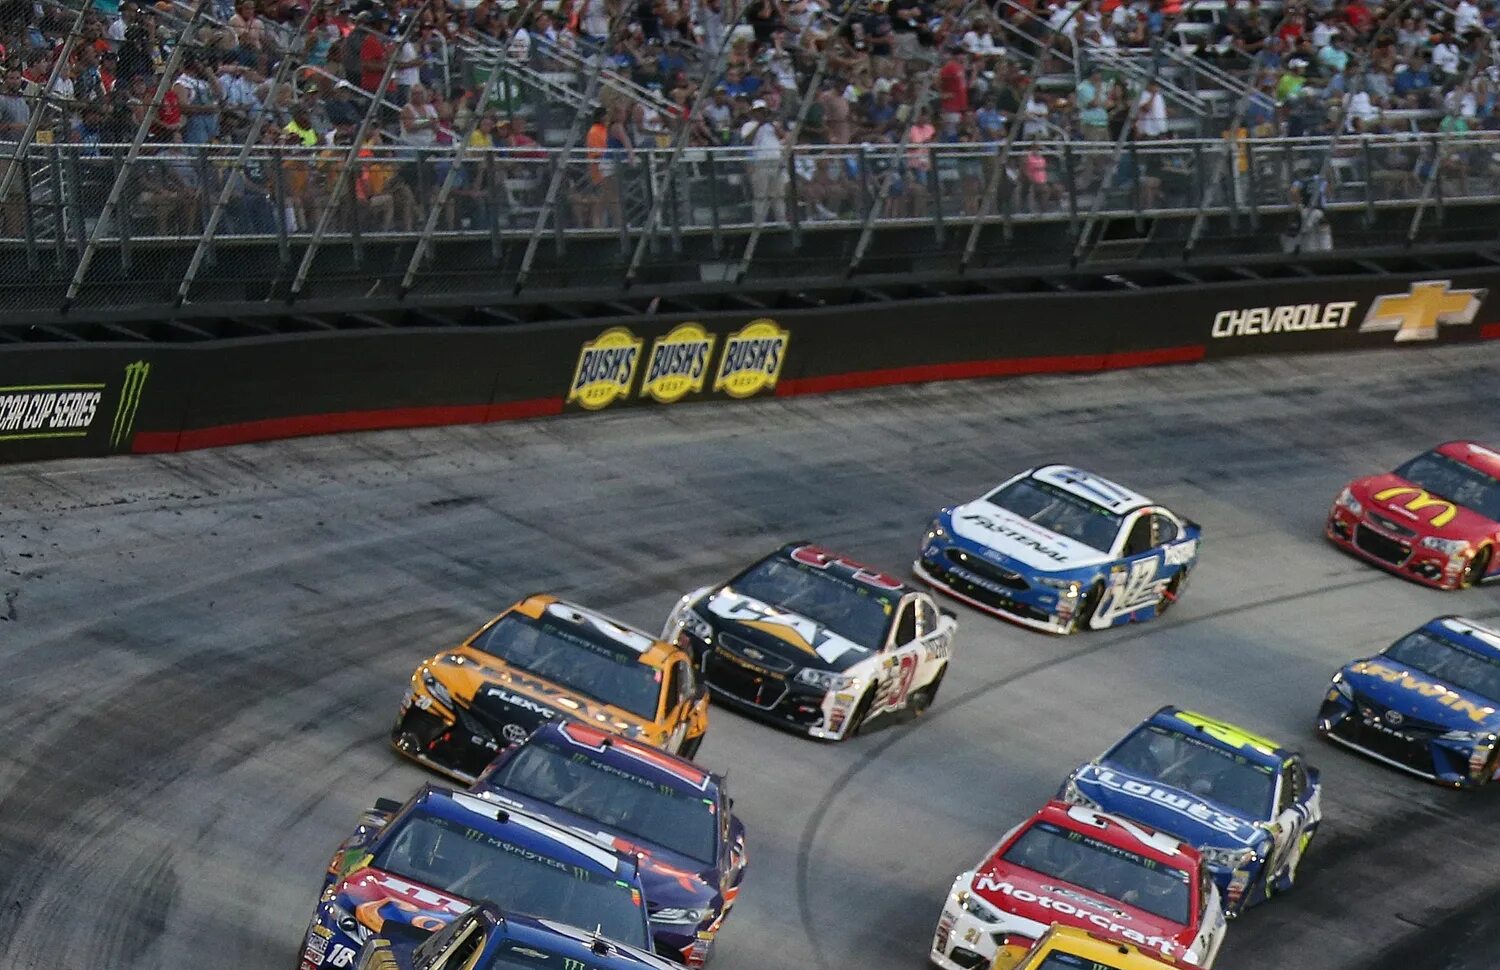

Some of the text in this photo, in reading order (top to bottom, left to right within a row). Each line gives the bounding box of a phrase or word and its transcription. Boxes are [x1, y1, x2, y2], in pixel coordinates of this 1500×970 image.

[1211, 301, 1357, 338] CHEVROLET
[574, 347, 637, 388] BUSH'S
[648, 342, 709, 382] BUSH'S
[722, 338, 783, 377] BUSH'S
[23, 394, 57, 429] CUP
[49, 392, 101, 428] SERIES
[961, 515, 1071, 563] FASTENAL
[488, 839, 568, 870] MONSTER
[977, 878, 1174, 954] Motorcraft
[326, 944, 356, 967] 18
